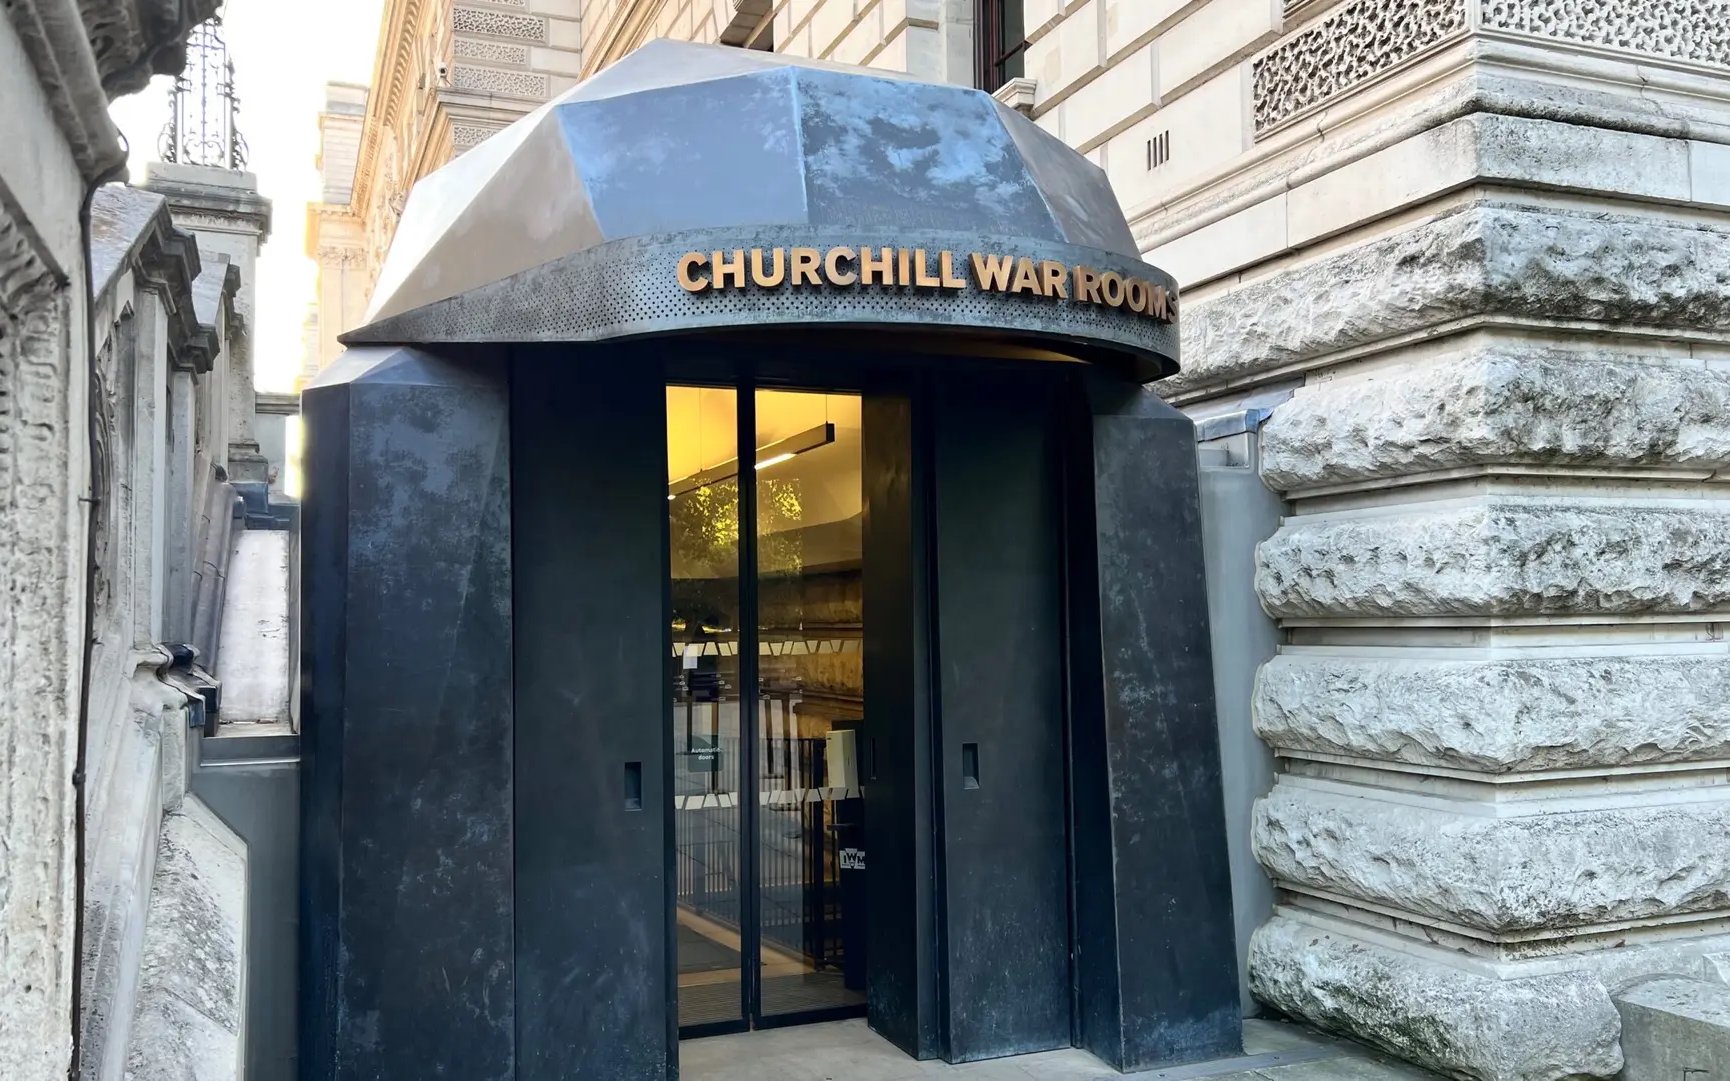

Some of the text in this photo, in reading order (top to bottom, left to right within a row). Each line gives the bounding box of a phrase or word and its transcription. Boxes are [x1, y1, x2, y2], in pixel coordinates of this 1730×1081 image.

[677, 246, 1179, 324] CHURCHILL WAR ROOMS
[844, 852, 865, 865] IWM
